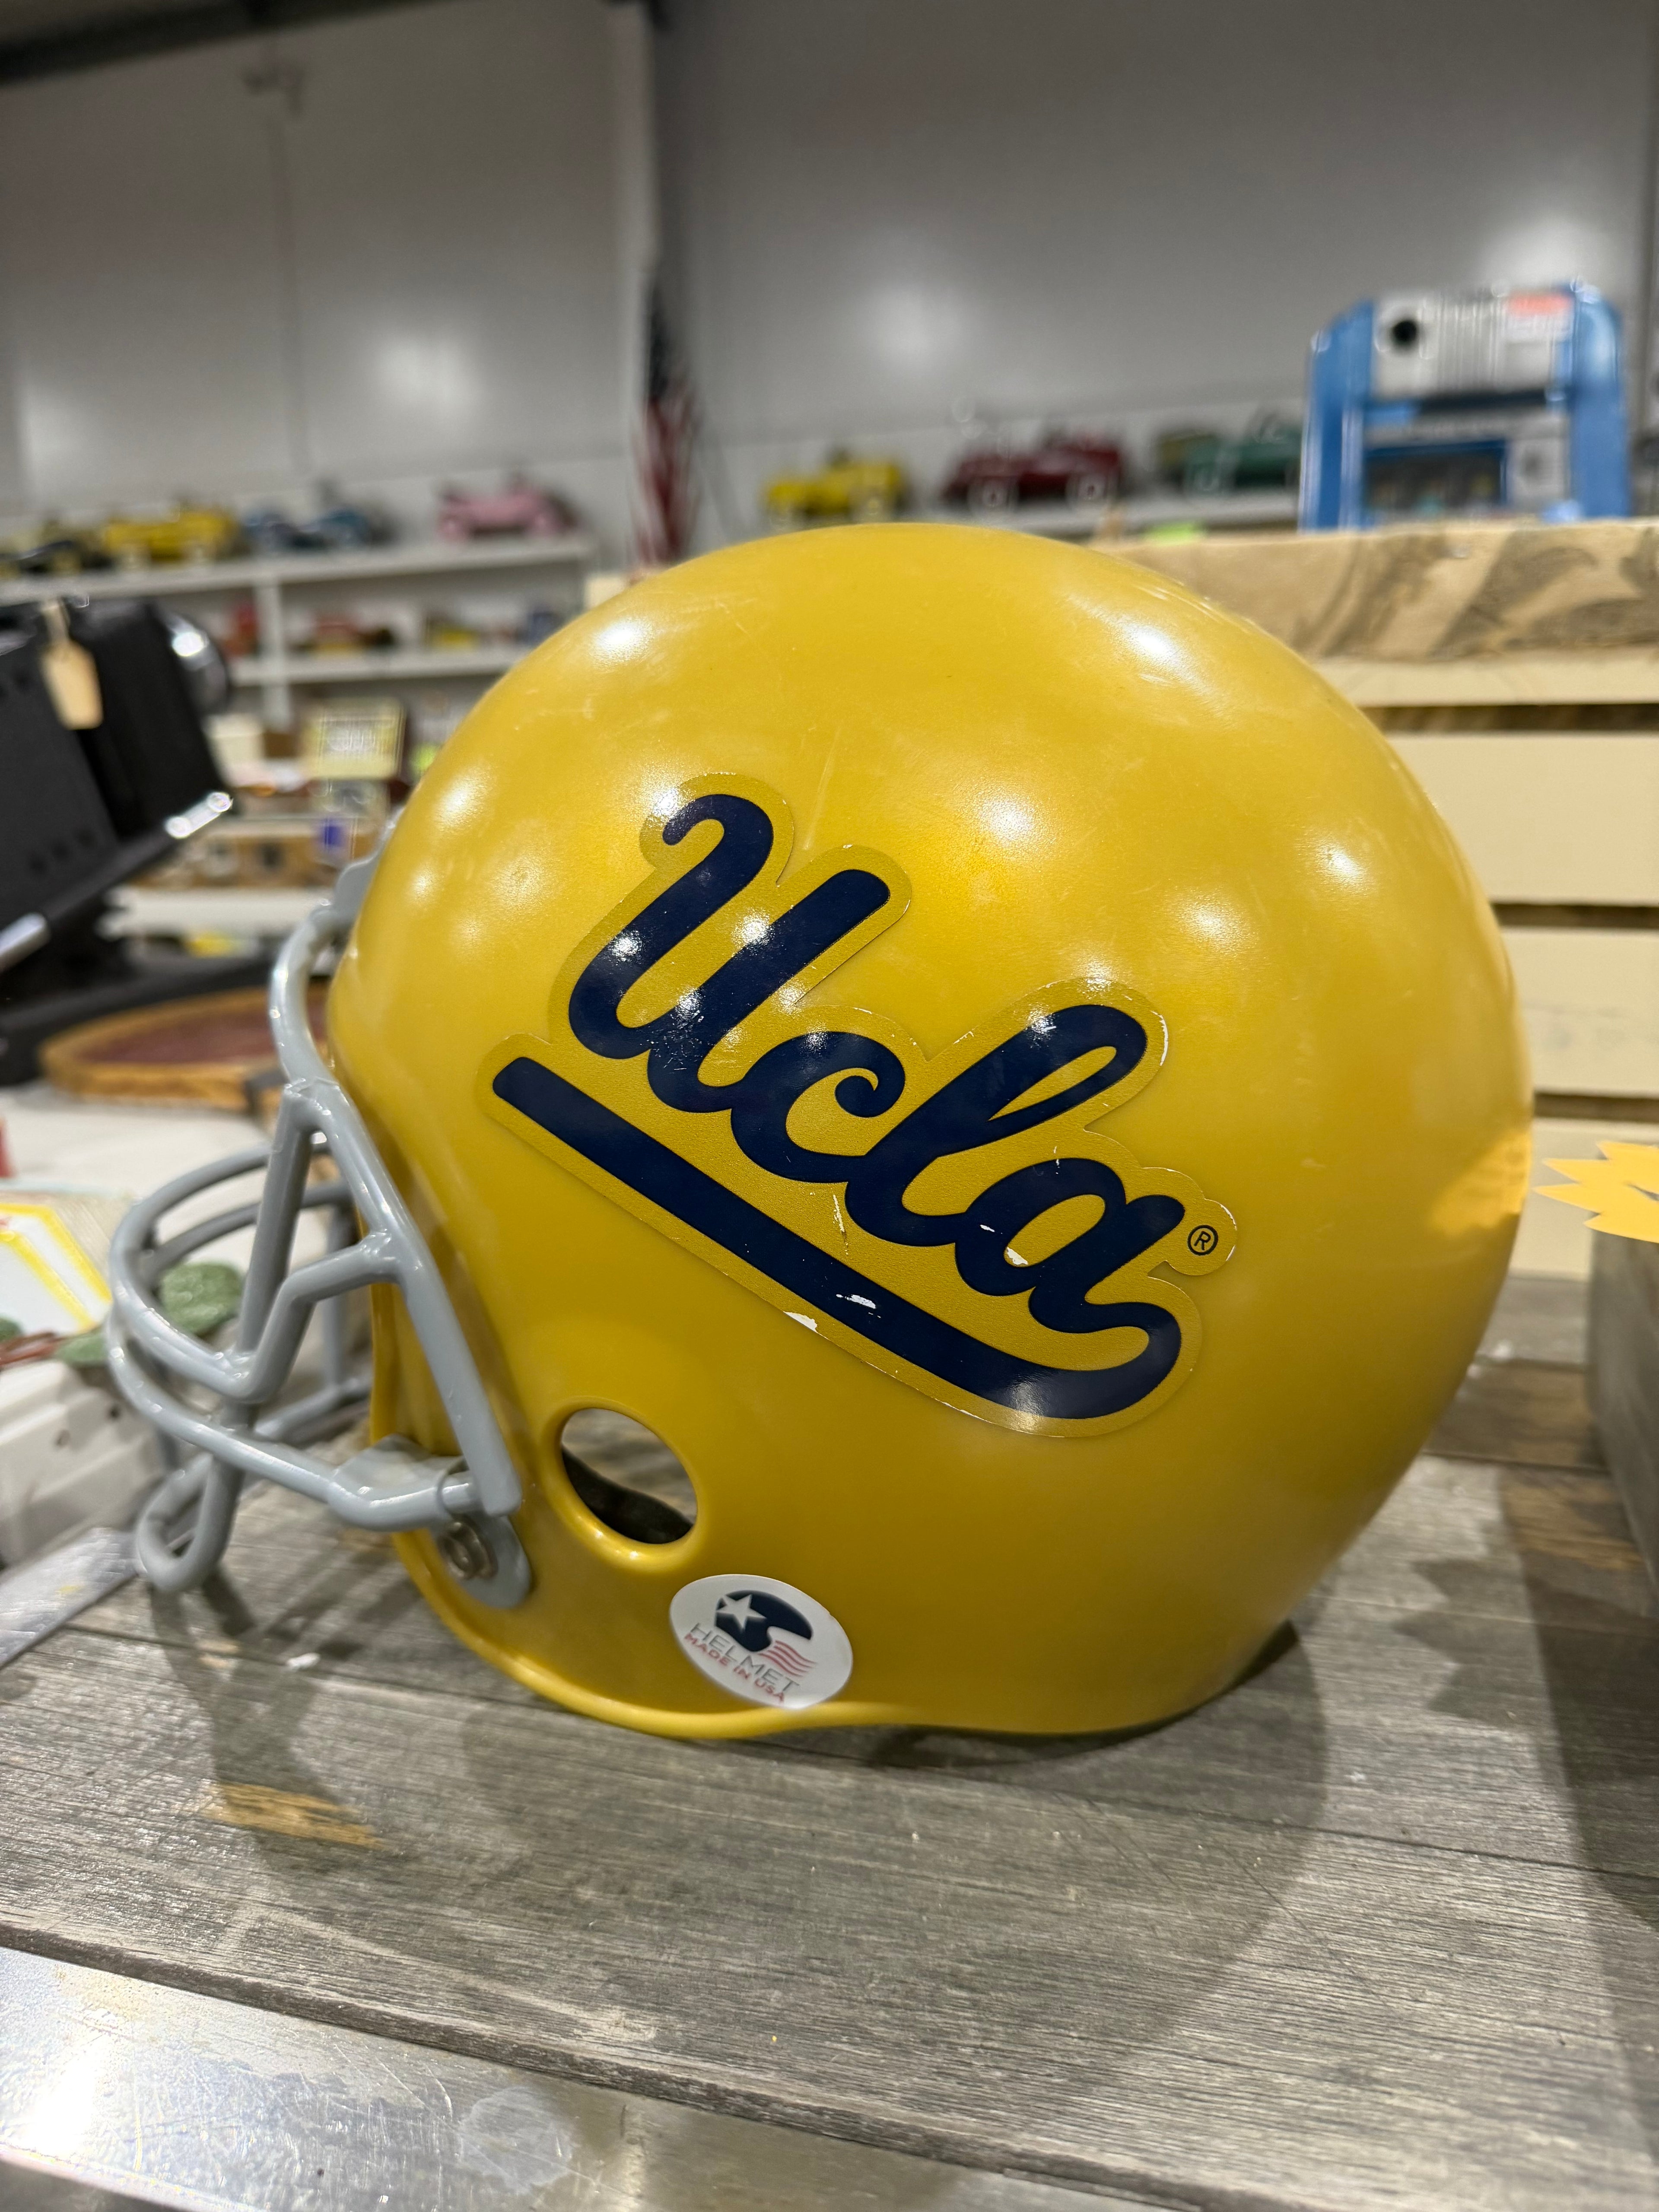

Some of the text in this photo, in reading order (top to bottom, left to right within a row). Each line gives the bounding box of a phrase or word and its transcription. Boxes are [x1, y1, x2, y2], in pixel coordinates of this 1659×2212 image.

[685, 1633, 784, 1702] MADE IN USA
[690, 1623, 800, 1691] HELMET
